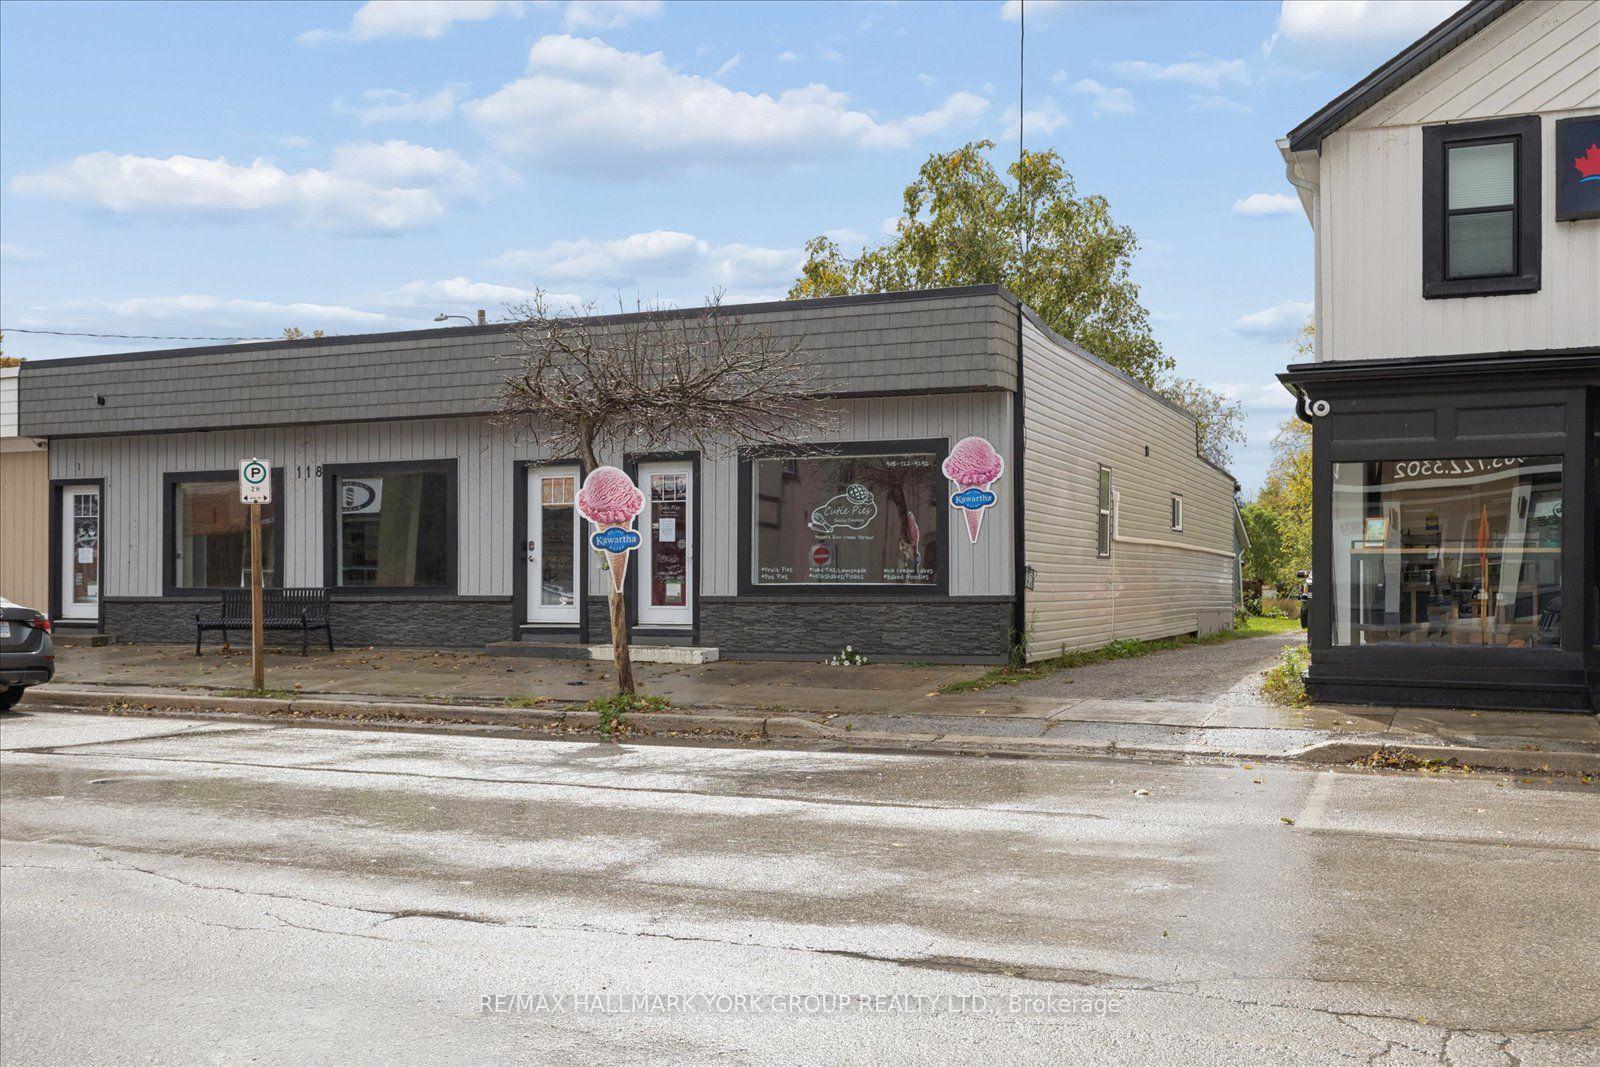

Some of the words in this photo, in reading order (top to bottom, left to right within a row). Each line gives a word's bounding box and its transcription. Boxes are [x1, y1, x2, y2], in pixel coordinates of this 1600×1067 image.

[251, 467, 261, 478] P
[296, 465, 322, 479] 118
[955, 495, 992, 504] Kawartha
[824, 506, 849, 516] Cutie
[852, 505, 872, 516] Pies
[596, 535, 637, 546] Kawartha
